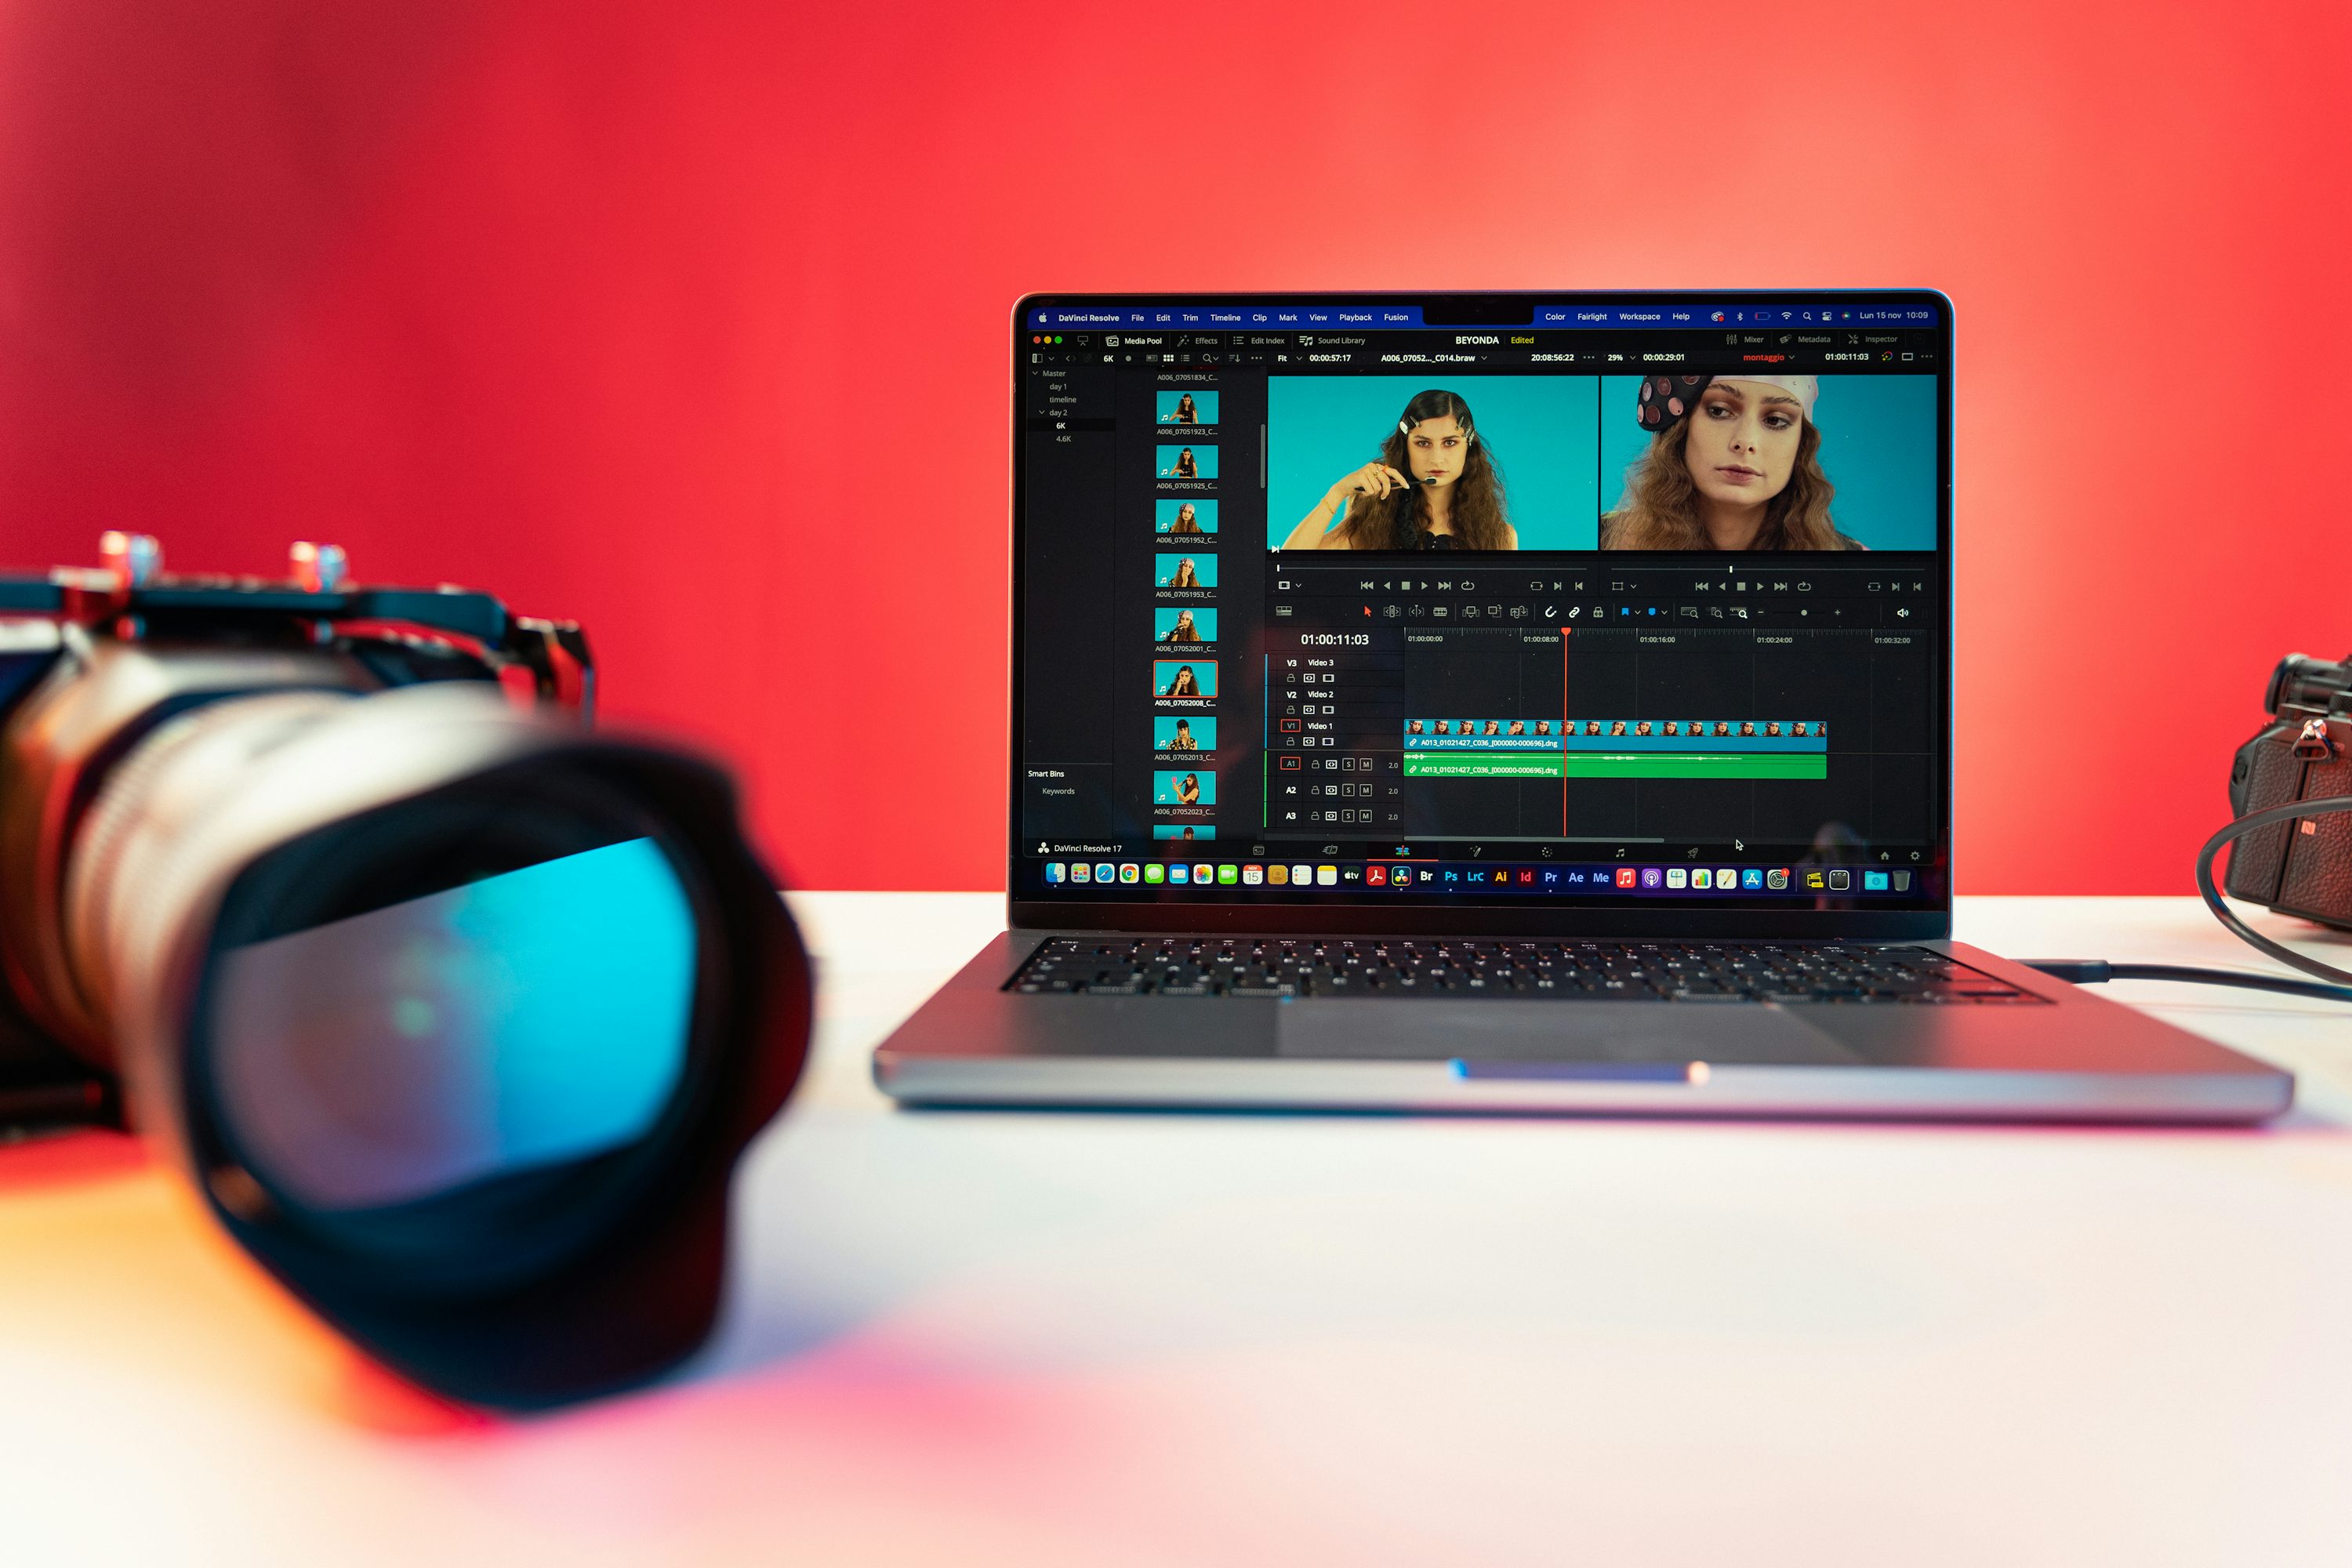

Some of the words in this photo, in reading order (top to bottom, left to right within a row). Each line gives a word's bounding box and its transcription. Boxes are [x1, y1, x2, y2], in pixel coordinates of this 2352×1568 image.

[1301, 634, 1369, 644] 01:00:11:03
[1421, 739, 1558, 748] A013_01021427_C036_[000000-000696].dng
[1421, 767, 1558, 775] A013_01021427_C036_[000000-000696].dng
[1247, 872, 1258, 882] 15
[1421, 871, 1432, 880] Br
[1445, 872, 1457, 880] Ps
[1468, 872, 1483, 881] LrC
[1495, 872, 1506, 881] Ai
[1521, 872, 1531, 881] Id
[1545, 873, 1557, 881] Pr
[1569, 873, 1584, 882] Ae
[1593, 873, 1609, 882] Me
